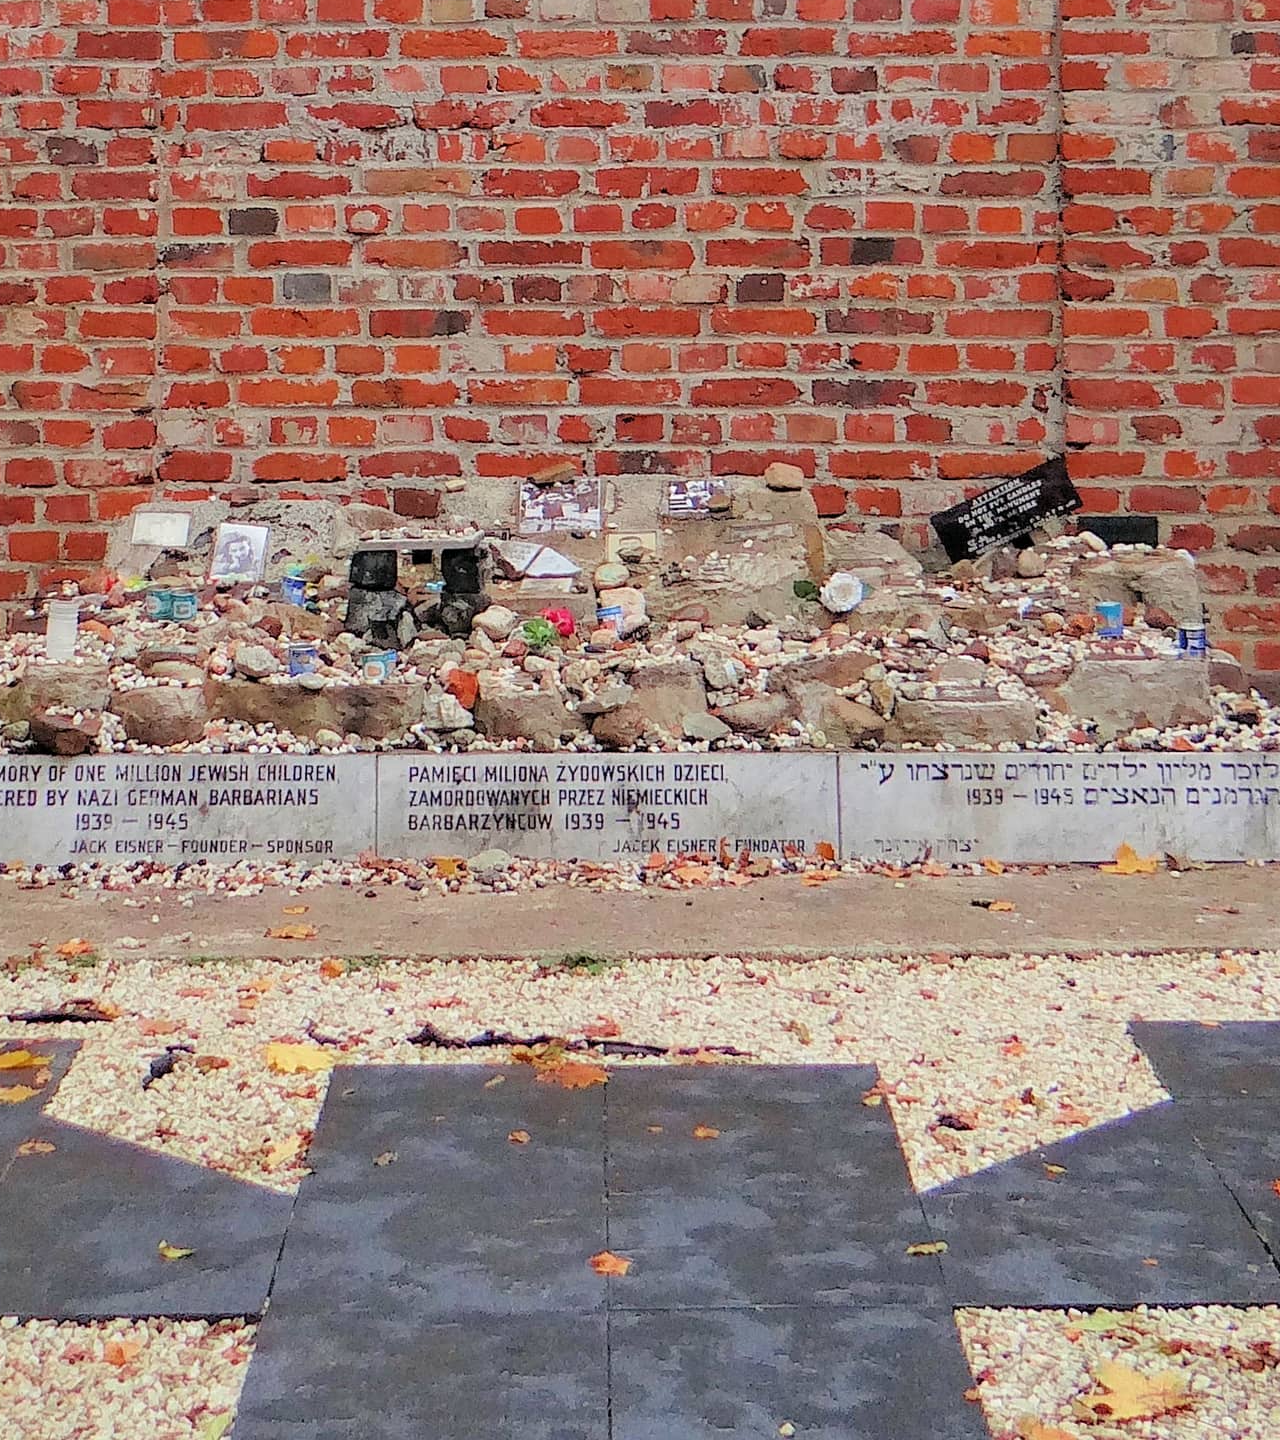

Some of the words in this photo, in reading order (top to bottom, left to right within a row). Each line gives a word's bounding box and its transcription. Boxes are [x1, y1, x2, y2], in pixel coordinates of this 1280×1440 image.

[48, 764, 68, 782] OF
[74, 764, 106, 782] ONE
[115, 764, 182, 782] MILLION
[188, 764, 249, 782] JEWISH
[408, 765, 477, 786] PAMIĘCI
[484, 765, 550, 783] MILIONA
[556, 760, 666, 783] ŻYDOWSKICH
[905, 762, 997, 782] שנרצחו
[1081, 755, 1148, 782] ילדים
[1156, 756, 1213, 785] מליון
[1219, 755, 1280, 782] לזכר
[46, 789, 69, 807] BY
[76, 789, 119, 807] NAZI
[127, 788, 199, 807] GERMAN
[208, 788, 320, 807] BARBARIANS
[408, 789, 551, 808] ZAMORDOWANYCH
[559, 789, 606, 807] PRZEZ
[611, 788, 709, 808] NIEMIECKICH
[966, 787, 1004, 806] 1939
[1033, 787, 1075, 806] 1945
[1082, 787, 1177, 806] הנאצים
[75, 813, 113, 831] 1939
[147, 812, 189, 831] 1945
[564, 812, 605, 831] 1939
[639, 812, 681, 831] 1945
[69, 839, 107, 854] JACK
[115, 839, 164, 854] EISNER
[181, 839, 249, 854] FOUNDER
[267, 839, 334, 855] SPONSOR
[612, 839, 661, 854] JACEK
[666, 839, 717, 854] EISNER
